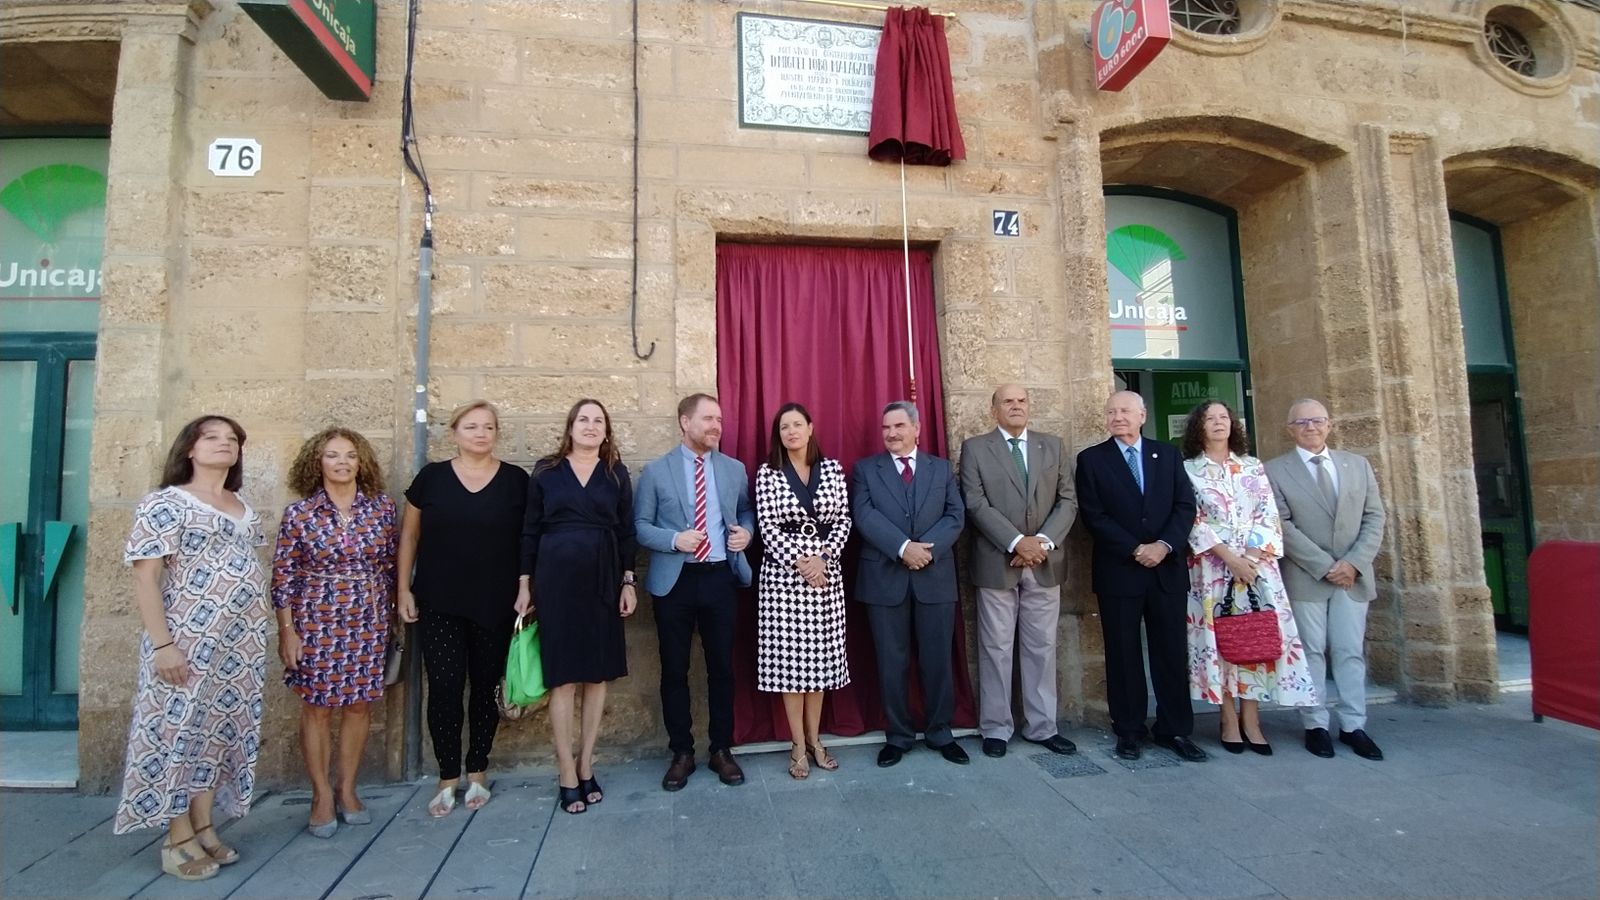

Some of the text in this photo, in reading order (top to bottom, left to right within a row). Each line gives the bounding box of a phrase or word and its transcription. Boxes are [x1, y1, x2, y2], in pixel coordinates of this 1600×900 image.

[1098, 26, 1143, 81] EURO 6000
[215, 144, 255, 171] 76
[994, 211, 1019, 235] 74
[0, 259, 103, 293] Unicaj
[1171, 381, 1200, 398] ATM
